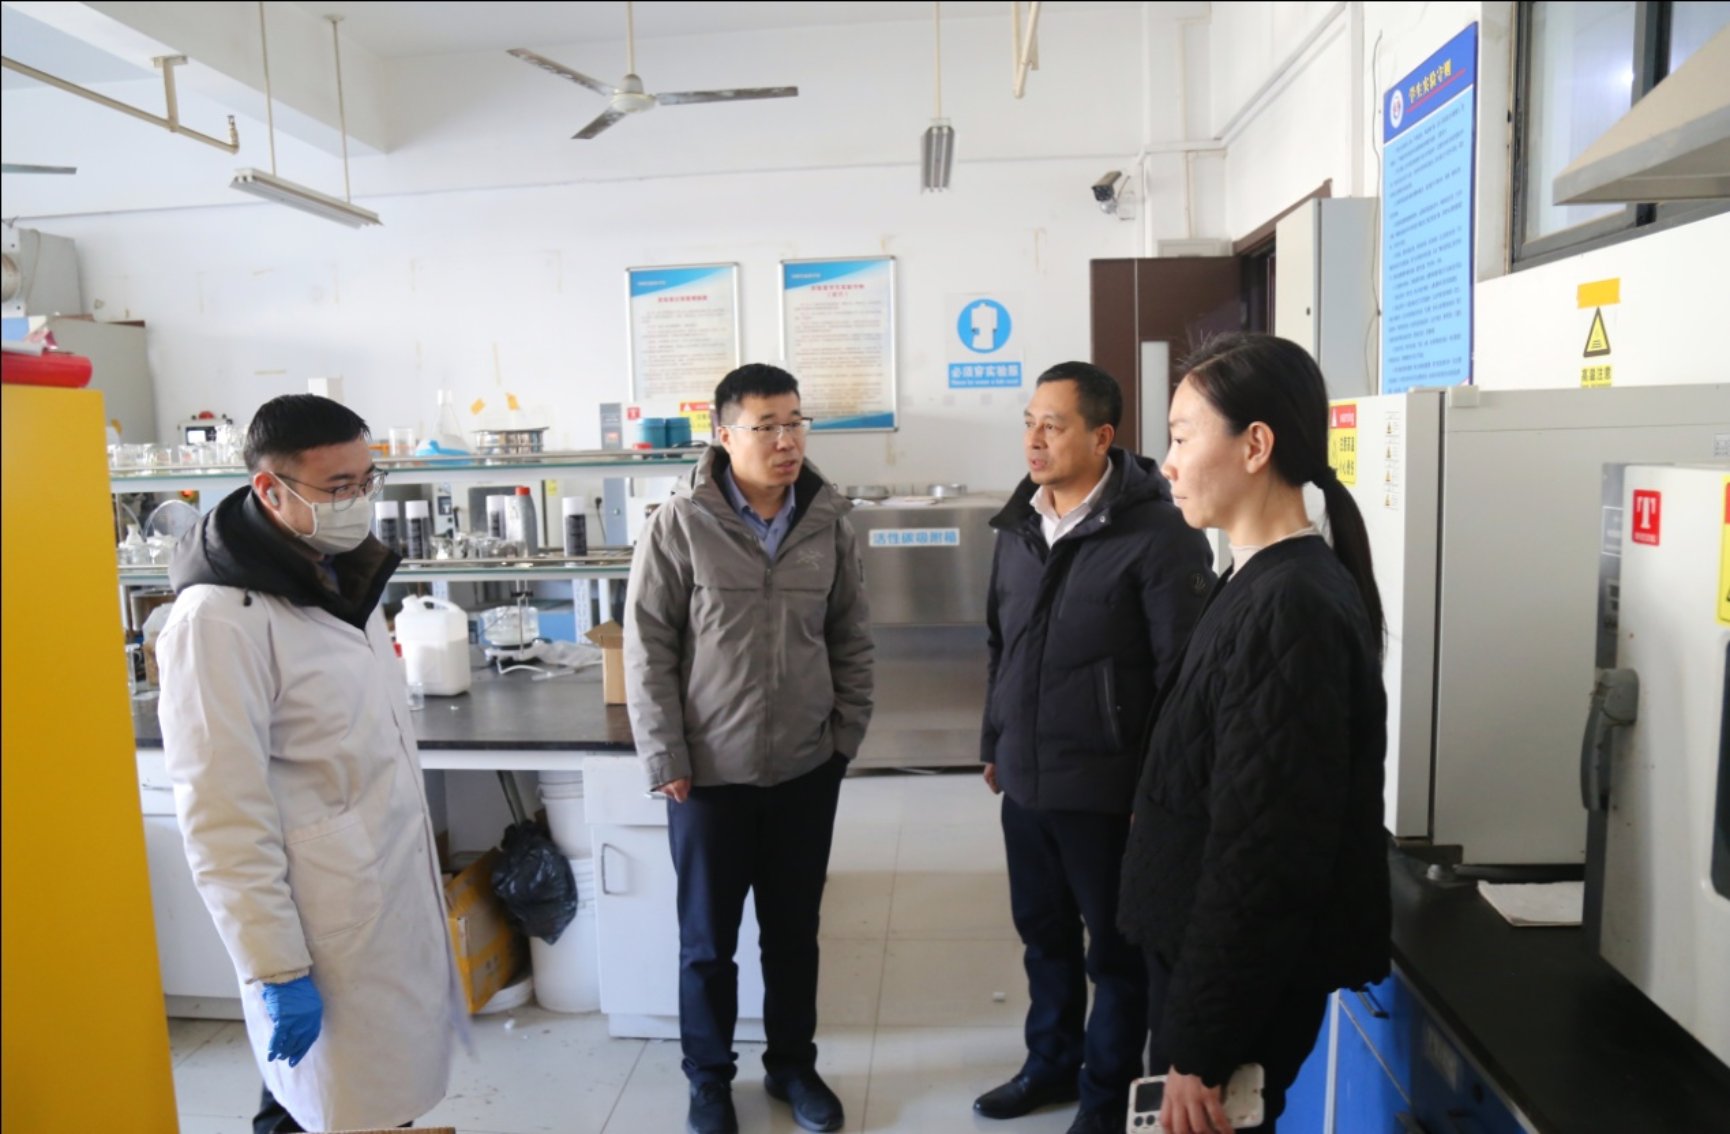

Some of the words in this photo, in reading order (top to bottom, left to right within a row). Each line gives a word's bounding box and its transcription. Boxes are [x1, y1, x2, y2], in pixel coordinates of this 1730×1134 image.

[1408, 58, 1452, 104] 学生实验守则
[951, 365, 1019, 377] 必须穿实验服
[1636, 496, 1656, 529] T
[873, 531, 957, 545] 活性碳吸附箱
